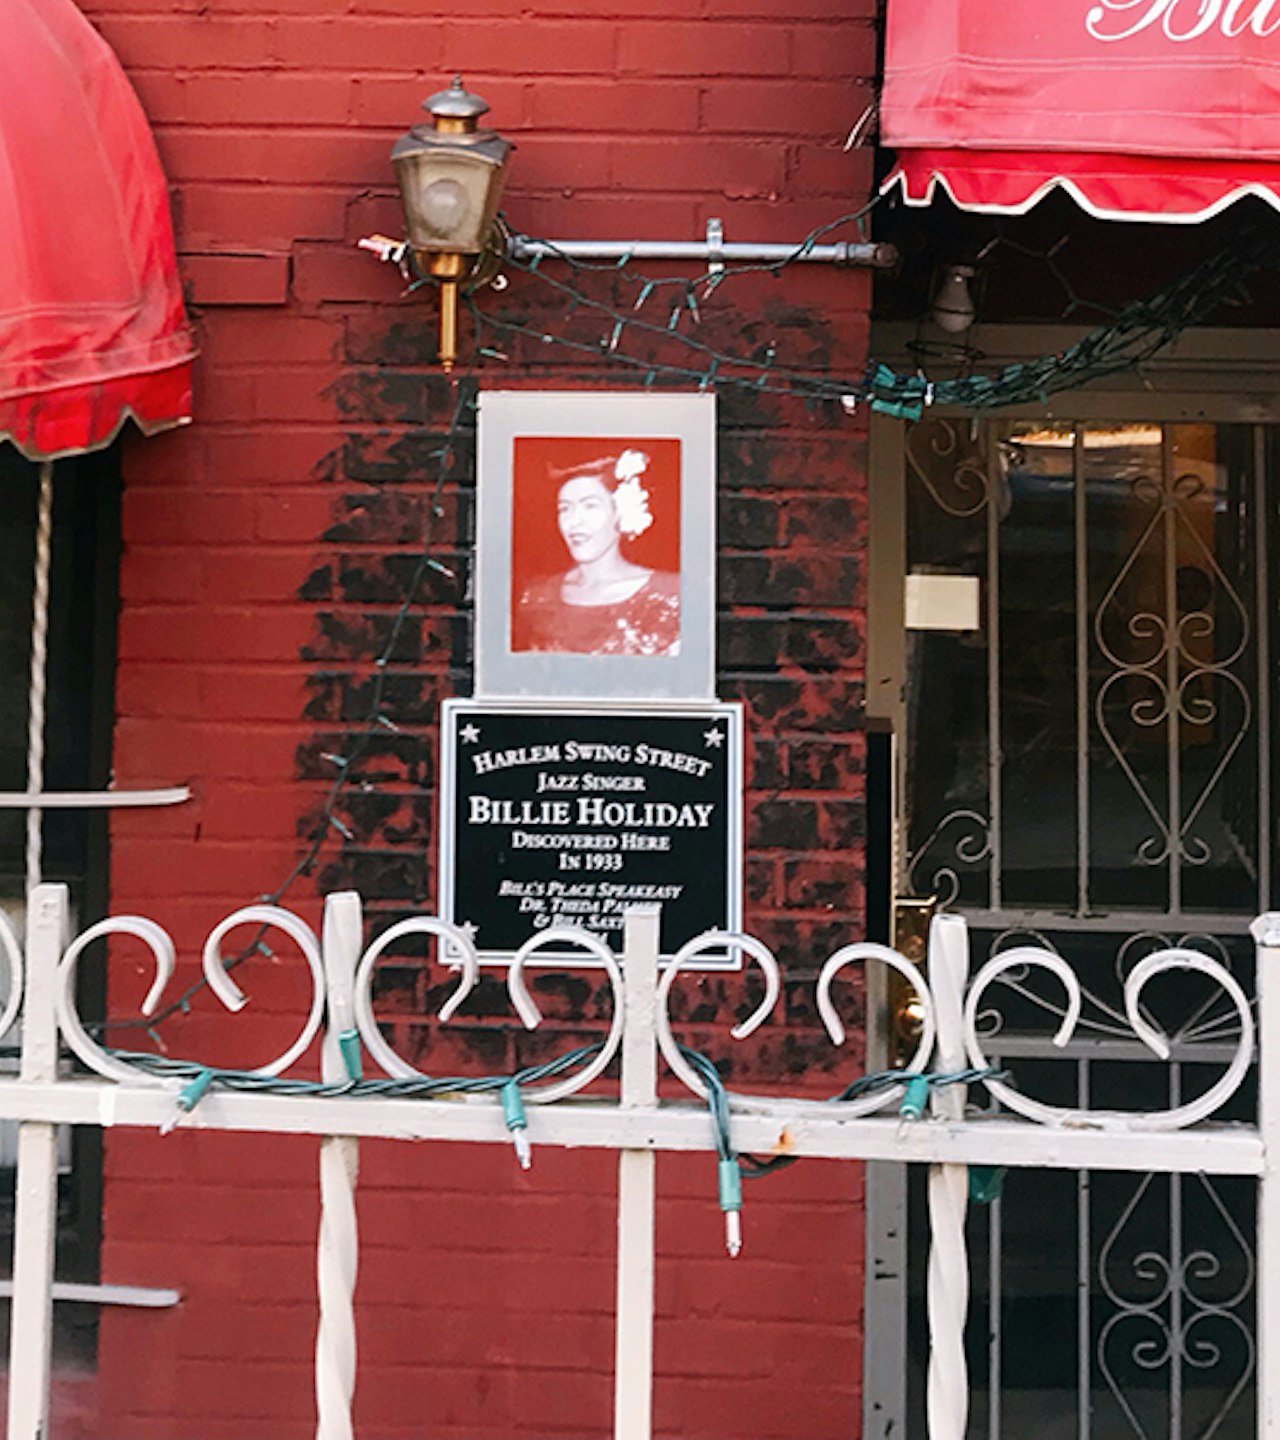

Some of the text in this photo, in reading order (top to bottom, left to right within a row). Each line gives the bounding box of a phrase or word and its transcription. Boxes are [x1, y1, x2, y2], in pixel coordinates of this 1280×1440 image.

[473, 741, 712, 776] HARLEM SWING STREET
[536, 772, 646, 793] JAZZ SINGER
[469, 795, 714, 827] BILLIE HOLIDAY
[620, 833, 671, 851] HERE
[585, 853, 624, 872] 1933
[547, 882, 596, 897] PLACE
[598, 883, 684, 899] SPEAKEASY
[533, 915, 551, 929] &
